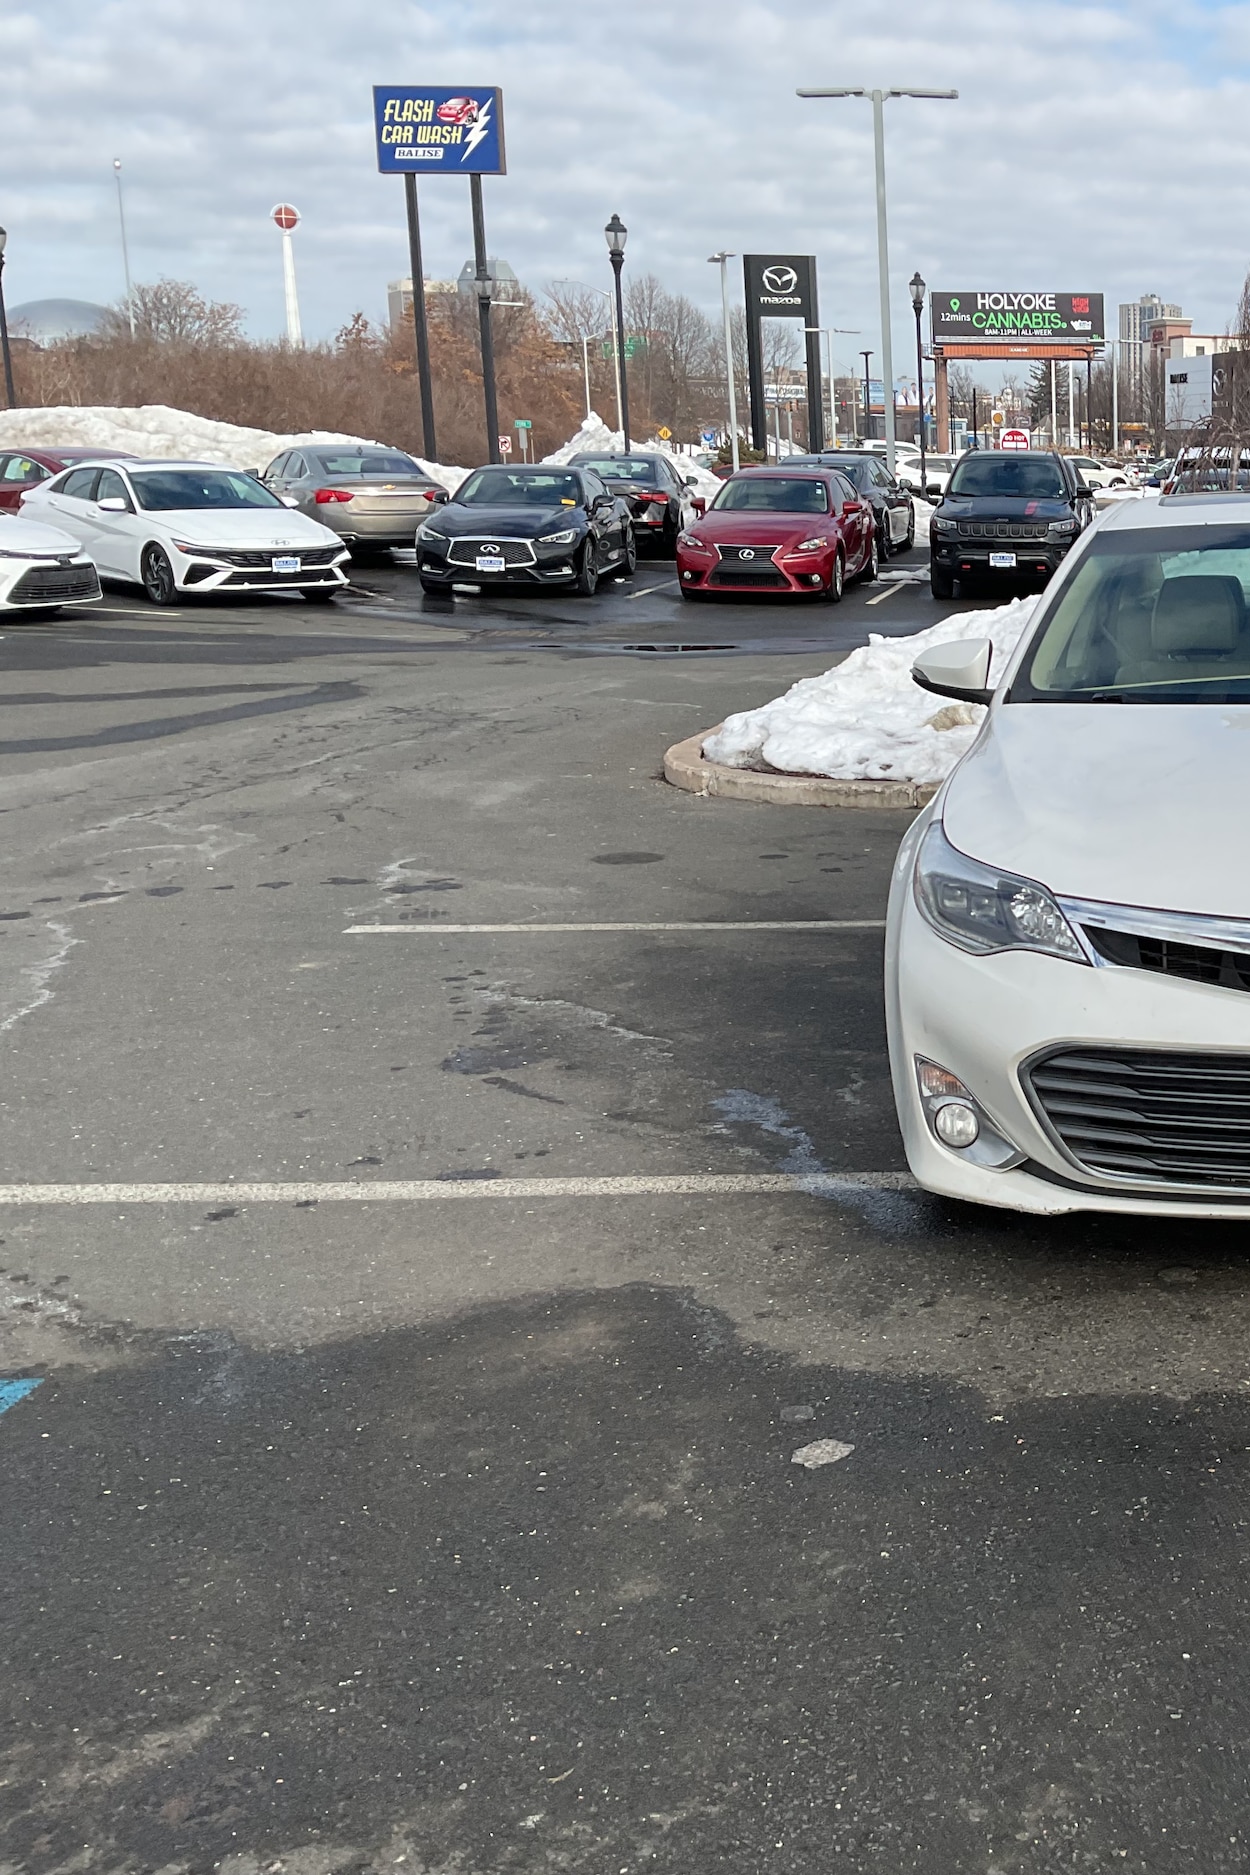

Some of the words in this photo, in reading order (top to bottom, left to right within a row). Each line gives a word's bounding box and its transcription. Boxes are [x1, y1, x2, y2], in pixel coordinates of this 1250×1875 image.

[384, 99, 434, 122] FLASH
[381, 125, 413, 144] CAR
[417, 125, 463, 144] WASH
[397, 149, 441, 158] BALISE
[977, 293, 1056, 310] HOLYOKE
[940, 312, 971, 322] 12mins
[984, 328, 1017, 336] 8AM-11PM
[1021, 328, 1053, 336] ALL-WEEK
